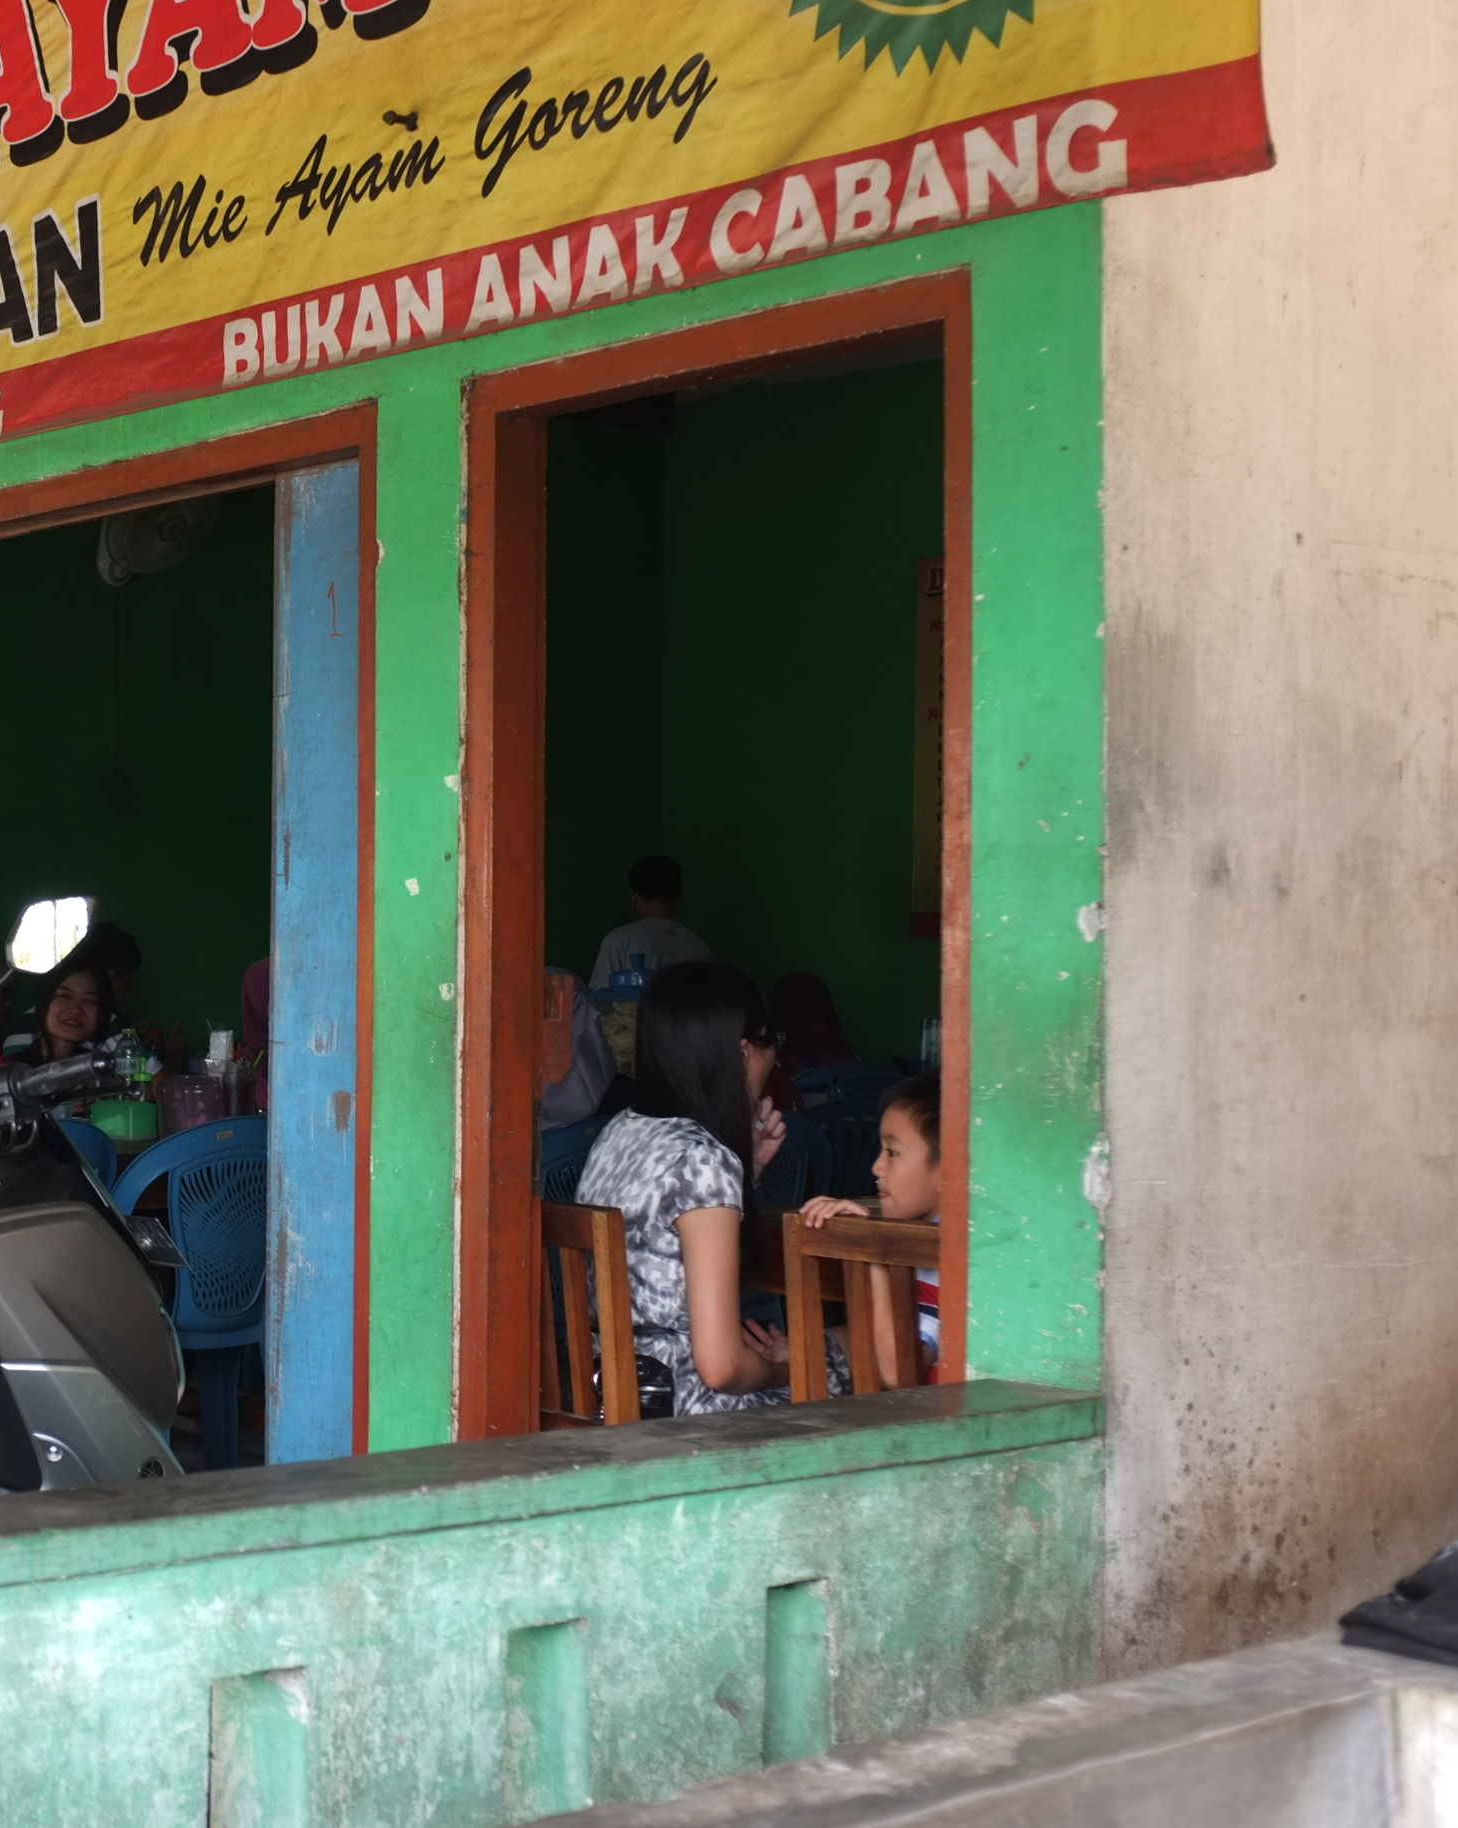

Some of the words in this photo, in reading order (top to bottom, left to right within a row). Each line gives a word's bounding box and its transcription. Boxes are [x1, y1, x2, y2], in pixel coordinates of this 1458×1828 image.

[132, 175, 249, 267] Mie
[265, 133, 446, 237] Ayam
[473, 52, 718, 199] Goreng
[222, 266, 444, 389] BUKAN
[461, 206, 690, 334] ANAK
[709, 99, 1129, 274] CABANG
